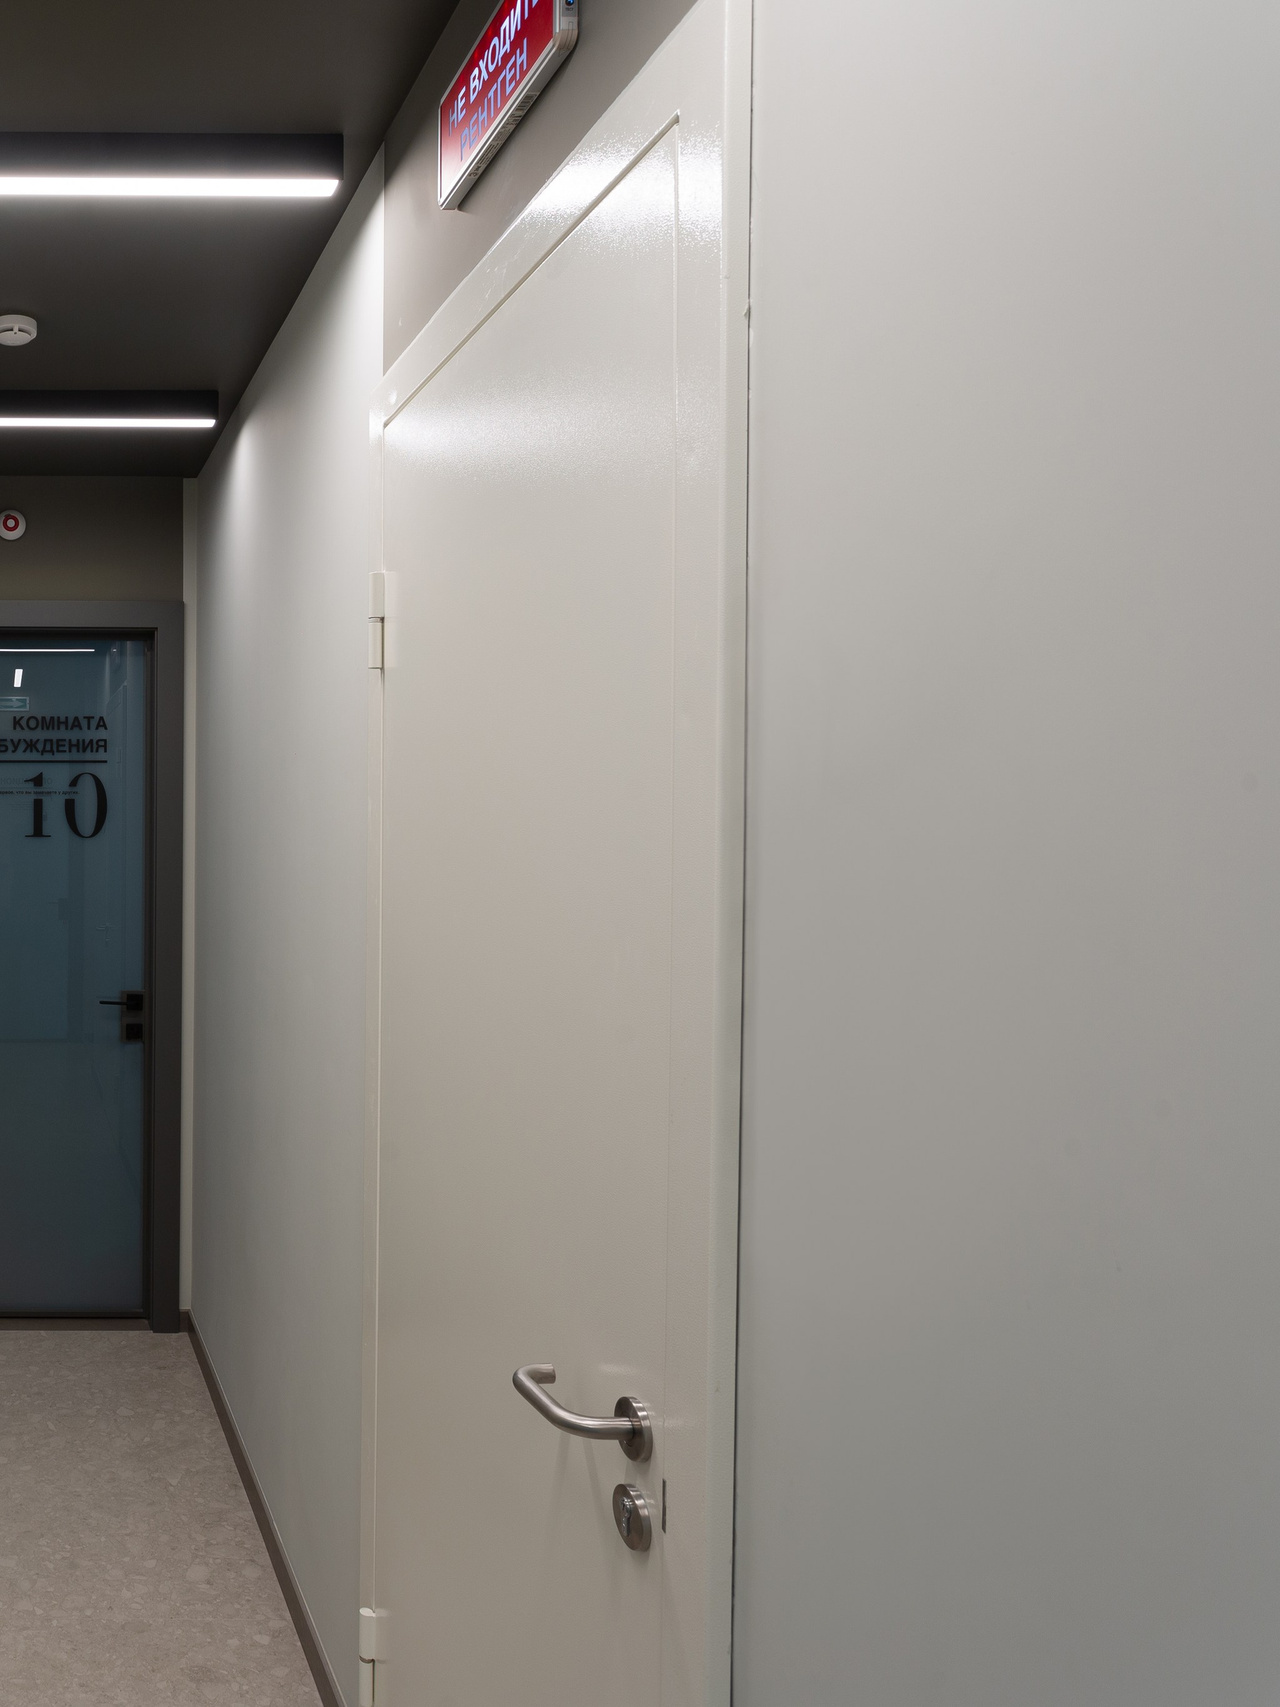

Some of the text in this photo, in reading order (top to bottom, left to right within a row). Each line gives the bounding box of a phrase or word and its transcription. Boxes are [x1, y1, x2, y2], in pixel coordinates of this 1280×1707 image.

[449, 86, 466, 137] НЕ
[470, 0, 539, 104] ВХОДИ
[460, 37, 528, 162] РЕНТГЕН
[12, 715, 108, 731] КОМНАТА
[23, 771, 108, 839] 10
